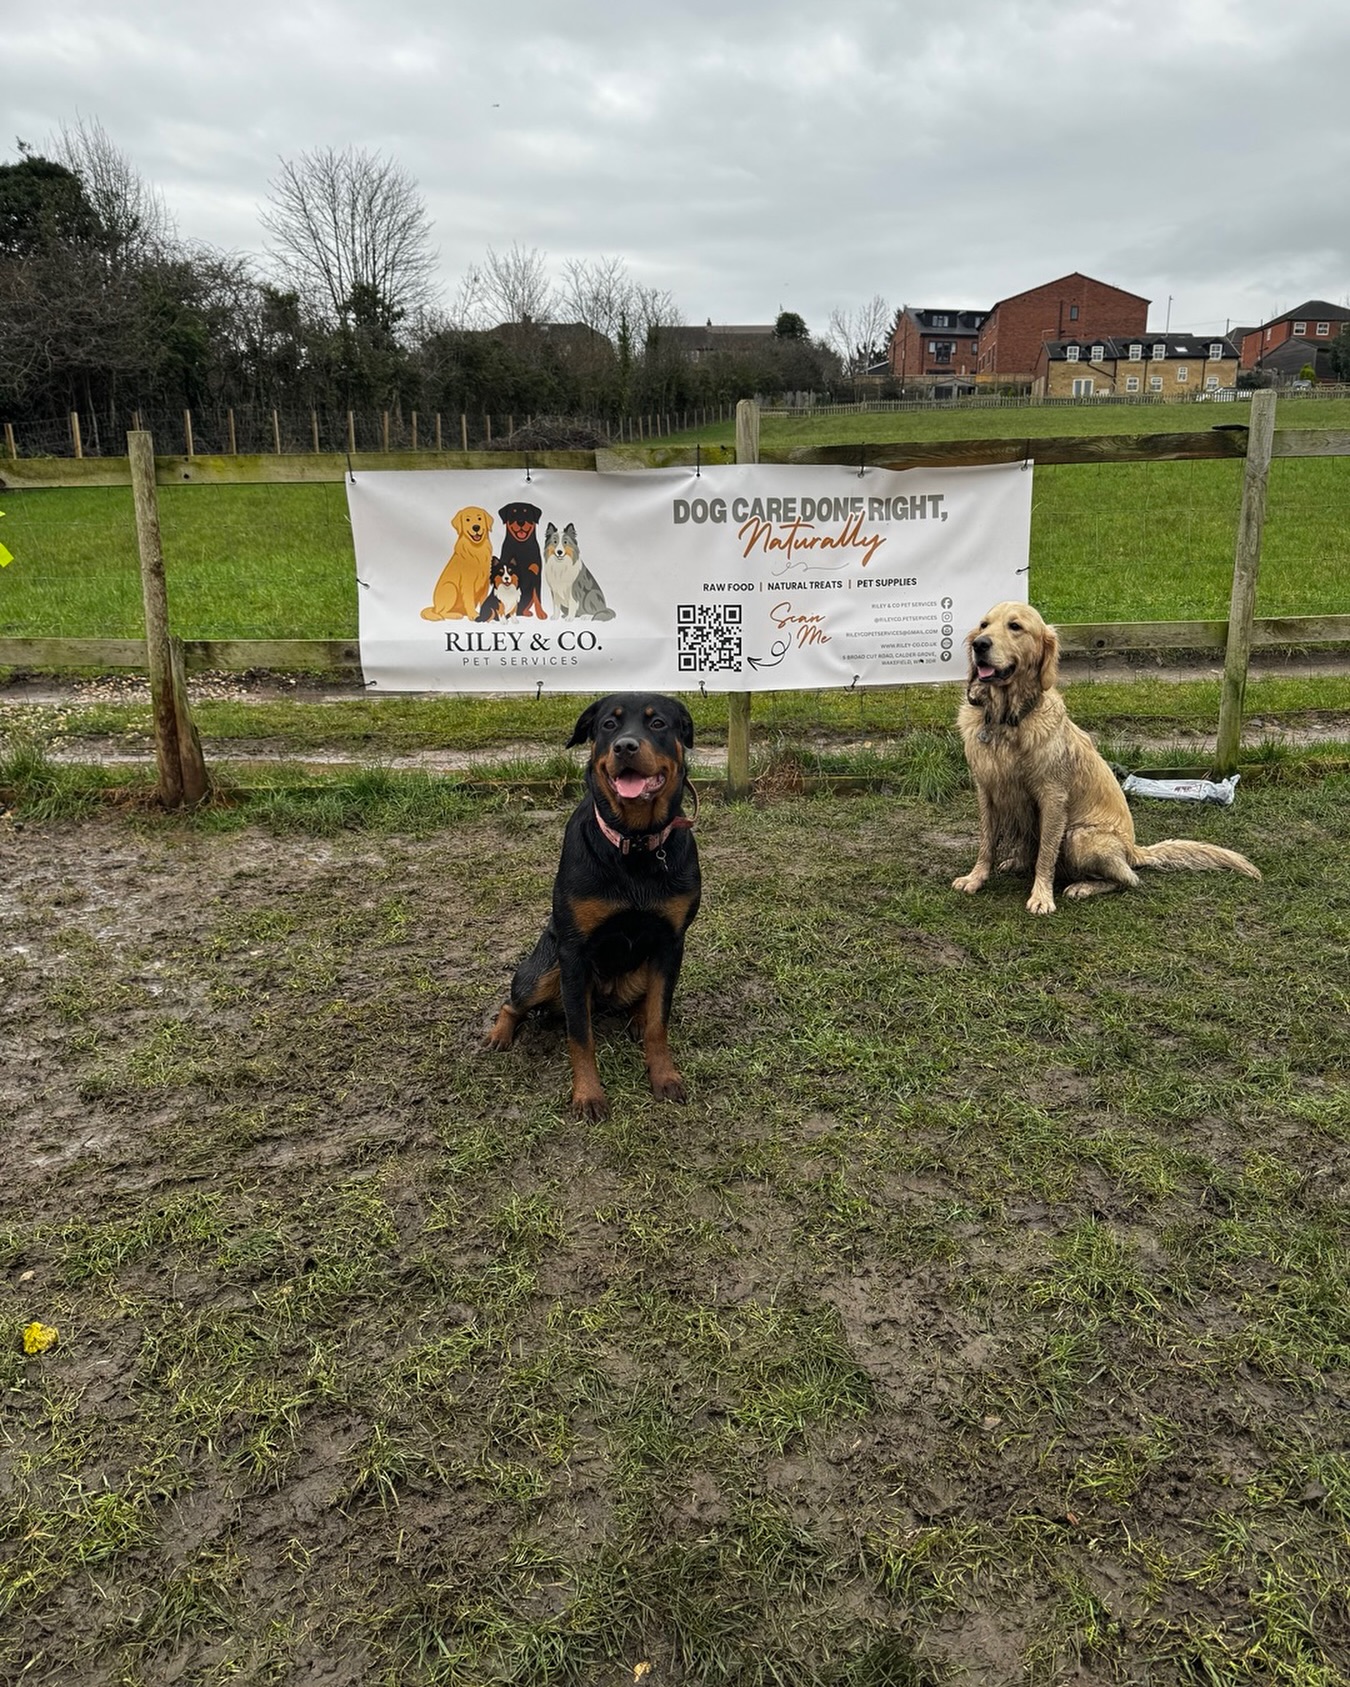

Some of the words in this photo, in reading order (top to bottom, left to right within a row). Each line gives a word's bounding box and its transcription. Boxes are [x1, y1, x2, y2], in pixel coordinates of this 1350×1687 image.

[673, 498, 727, 524] DOG
[732, 497, 797, 523] CARE
[800, 496, 864, 522] DONE
[869, 494, 949, 522] RIGHT,
[738, 511, 887, 567] Naturally
[703, 582, 726, 592] RAW
[727, 582, 755, 592] FOOD
[767, 581, 808, 591] NATURAL
[809, 580, 843, 590] TREATS
[857, 578, 875, 588] PET
[876, 577, 917, 588] SUPPLIES
[770, 601, 826, 629] Scan
[445, 631, 525, 652] RILEY
[530, 633, 550, 650] &
[557, 631, 602, 651] CO.
[796, 625, 832, 649] Me
[846, 629, 938, 637] RILEYCOPETSERVICES@GMAIL.COM
[462, 656, 490, 666] PET
[500, 655, 579, 666] SERVICES
